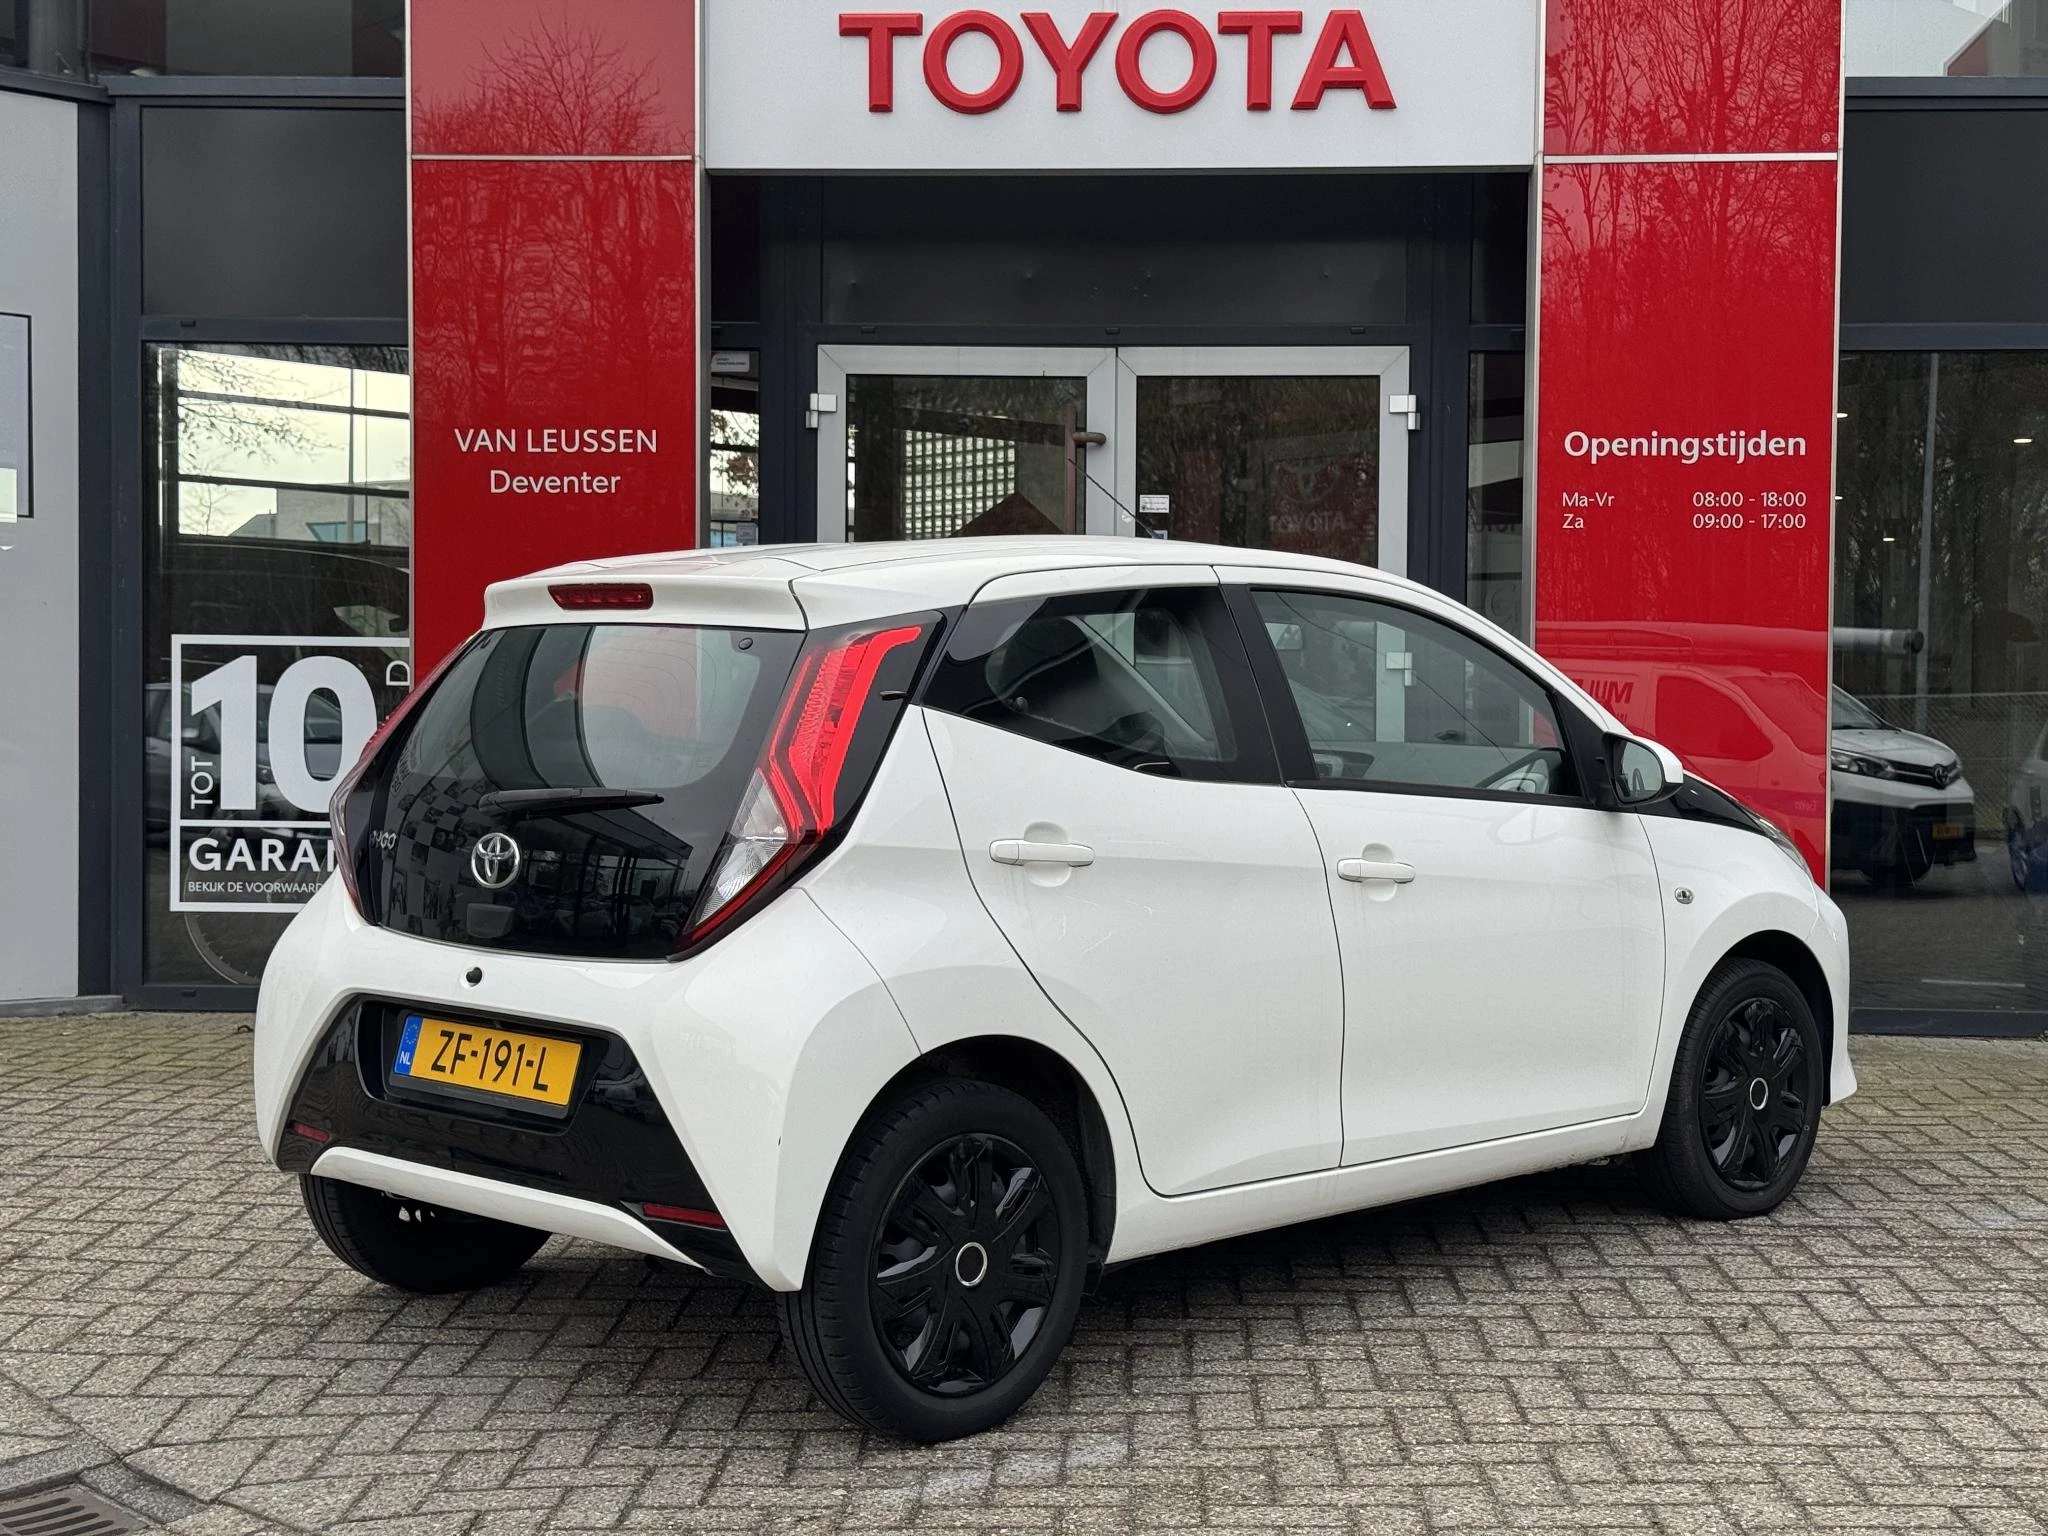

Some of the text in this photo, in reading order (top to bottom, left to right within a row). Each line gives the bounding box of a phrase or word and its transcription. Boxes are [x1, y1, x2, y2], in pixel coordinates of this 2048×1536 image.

[839, 9, 1397, 114] TOYOTA
[454, 428, 657, 453] VAN LEUSSEN
[1564, 430, 1806, 464] Openingstijden
[490, 469, 621, 493] Deventer
[1562, 491, 1614, 507] Ma-Vr
[1692, 491, 1743, 507] 08:00
[1760, 491, 1807, 507] 18:00
[1562, 513, 1584, 529] Za
[1692, 513, 1743, 529] 09:00
[1760, 513, 1806, 529] 17:00
[191, 655, 377, 813] 10
[191, 756, 214, 809] TOT
[188, 881, 225, 892] BEKIJK
[227, 881, 243, 893] DE
[400, 1030, 548, 1092] NL ZF-191-L
